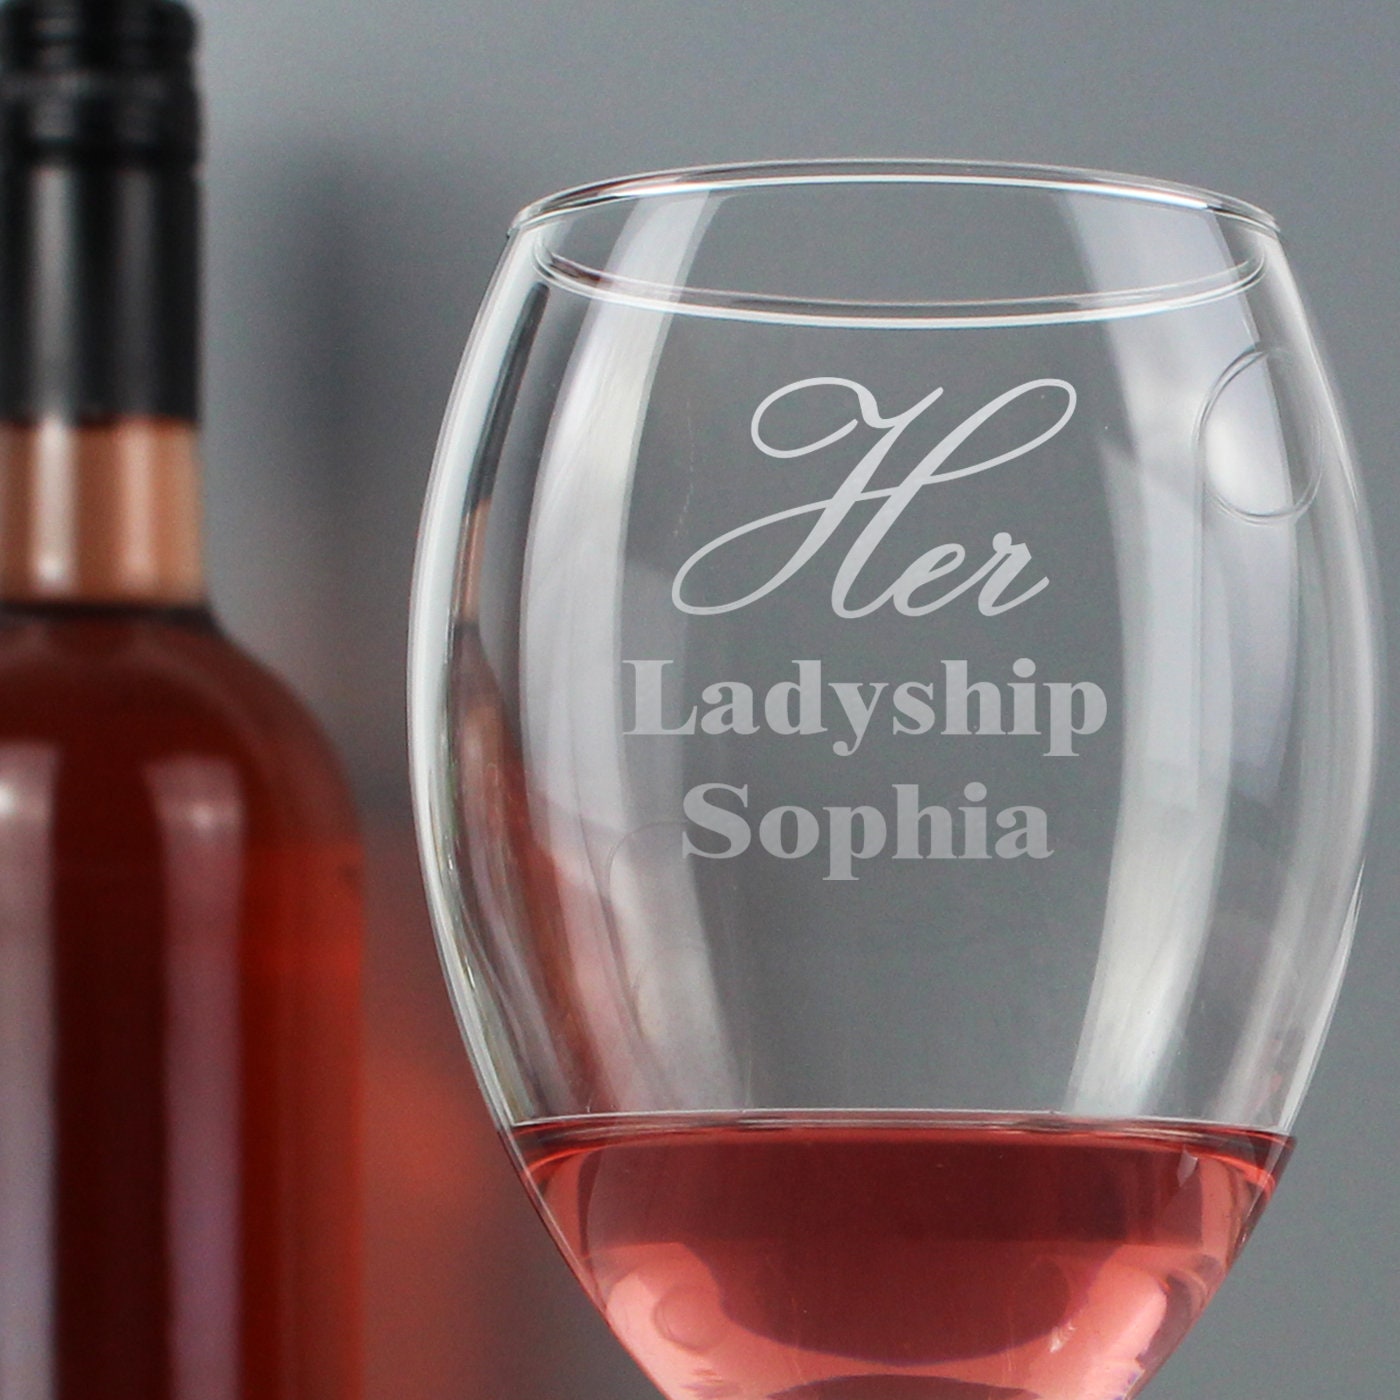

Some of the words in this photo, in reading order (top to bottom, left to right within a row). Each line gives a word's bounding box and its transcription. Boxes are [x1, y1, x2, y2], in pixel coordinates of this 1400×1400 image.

[671, 377, 1077, 619] Her
[622, 657, 1108, 757] Ladyship
[681, 781, 1055, 881] Sophia
